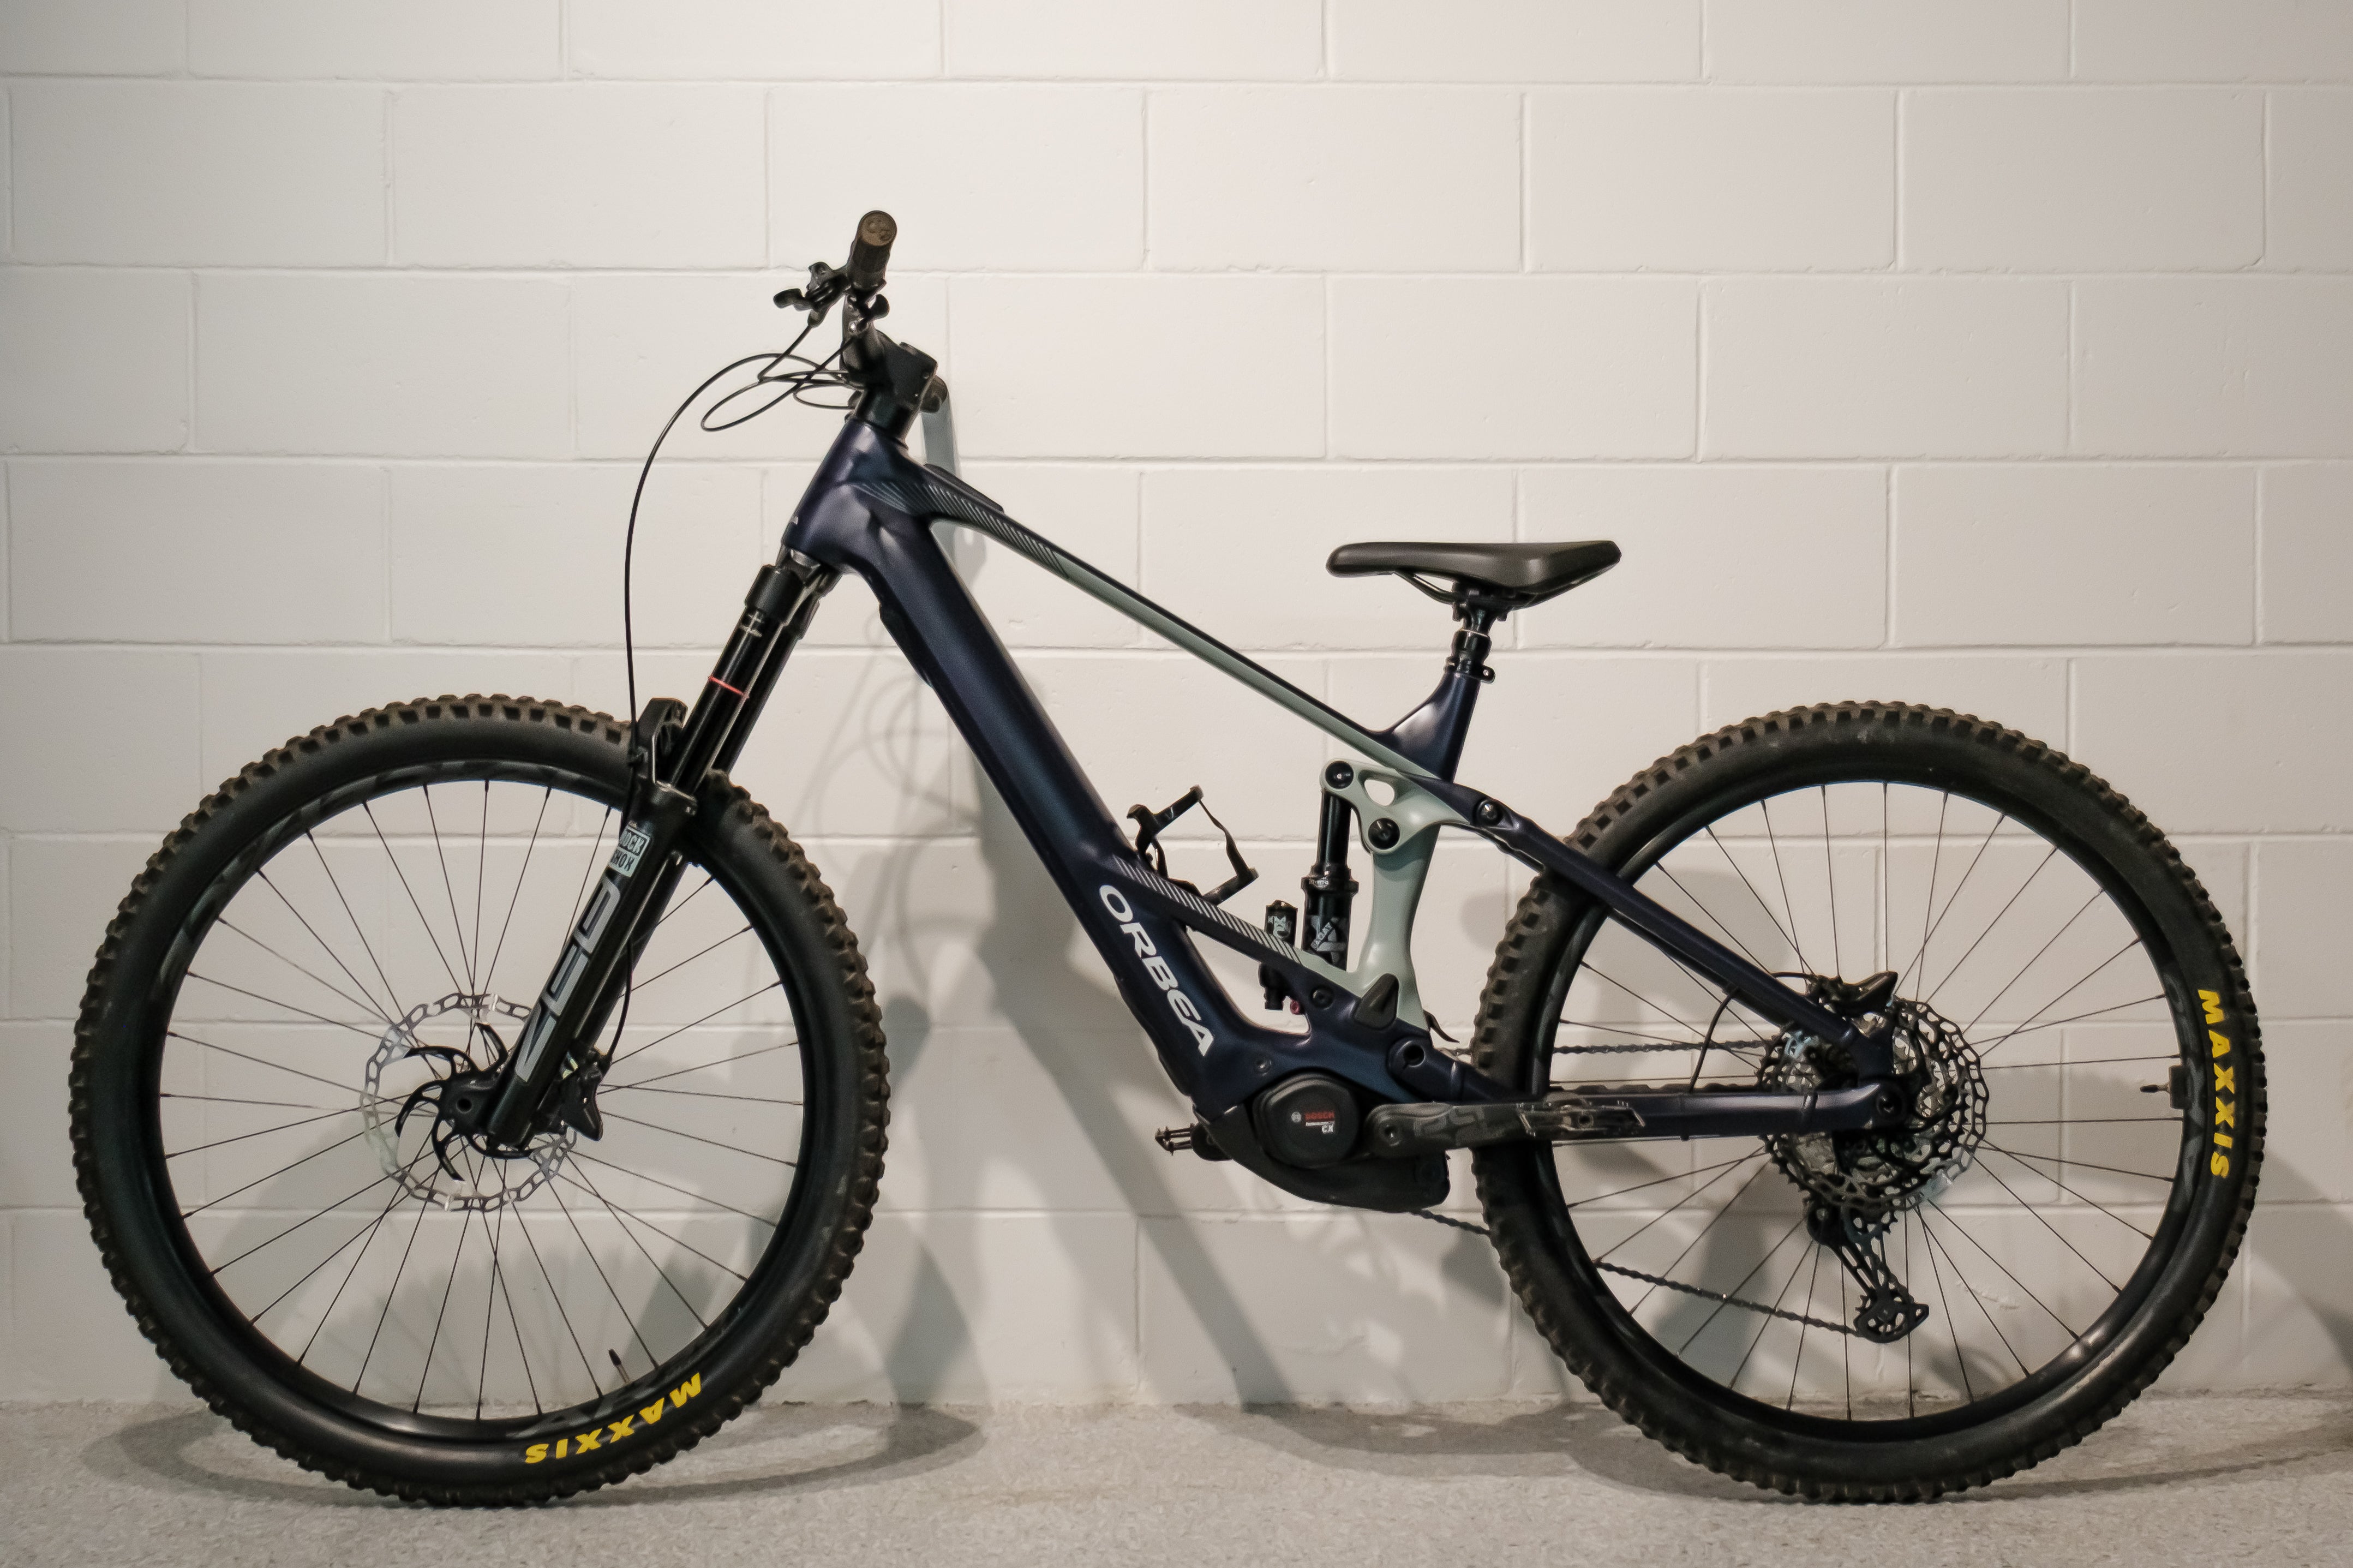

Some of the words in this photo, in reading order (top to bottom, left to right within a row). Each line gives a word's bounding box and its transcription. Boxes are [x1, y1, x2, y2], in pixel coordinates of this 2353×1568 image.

[1099, 884, 1215, 1057] ORBEA
[2198, 989, 2235, 1178] MAXXIS
[525, 1372, 702, 1464] MAXXIS
